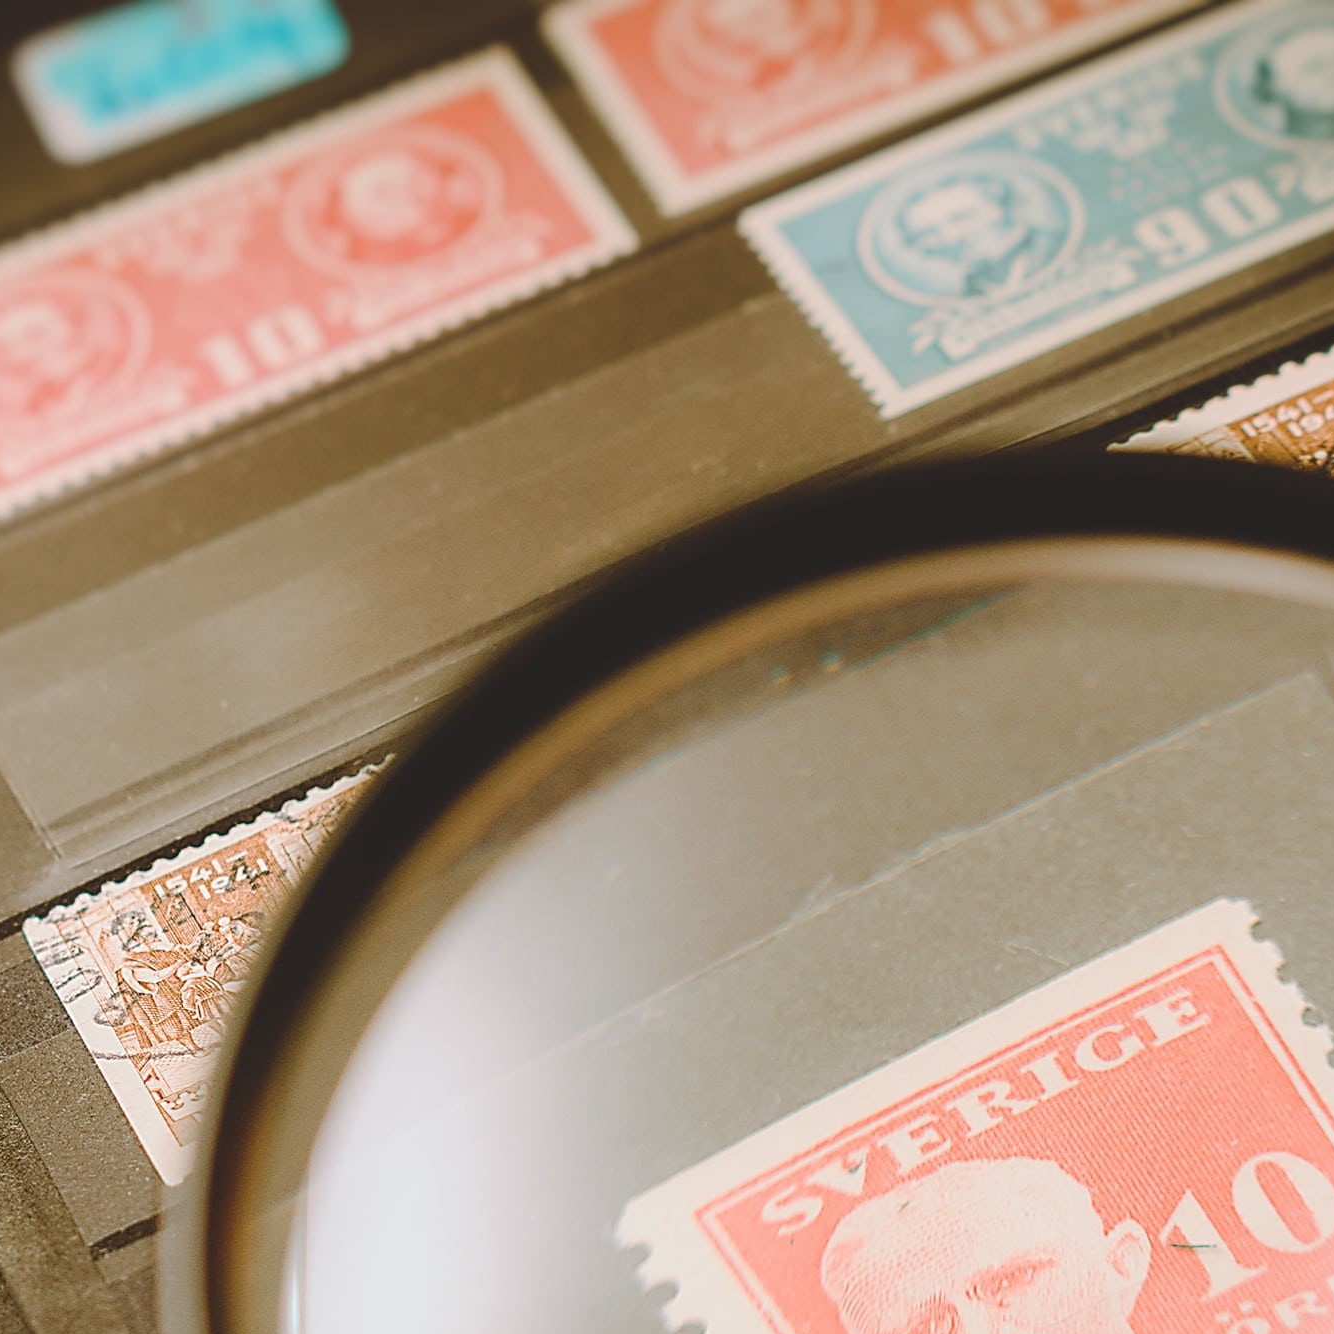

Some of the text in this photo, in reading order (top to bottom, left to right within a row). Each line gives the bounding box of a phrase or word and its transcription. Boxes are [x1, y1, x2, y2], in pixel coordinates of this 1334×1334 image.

[1133, 176, 1281, 267] 90
[205, 303, 324, 387] 10
[198, 858, 270, 899] 1941
[760, 988, 1210, 1236] SVERIGE
